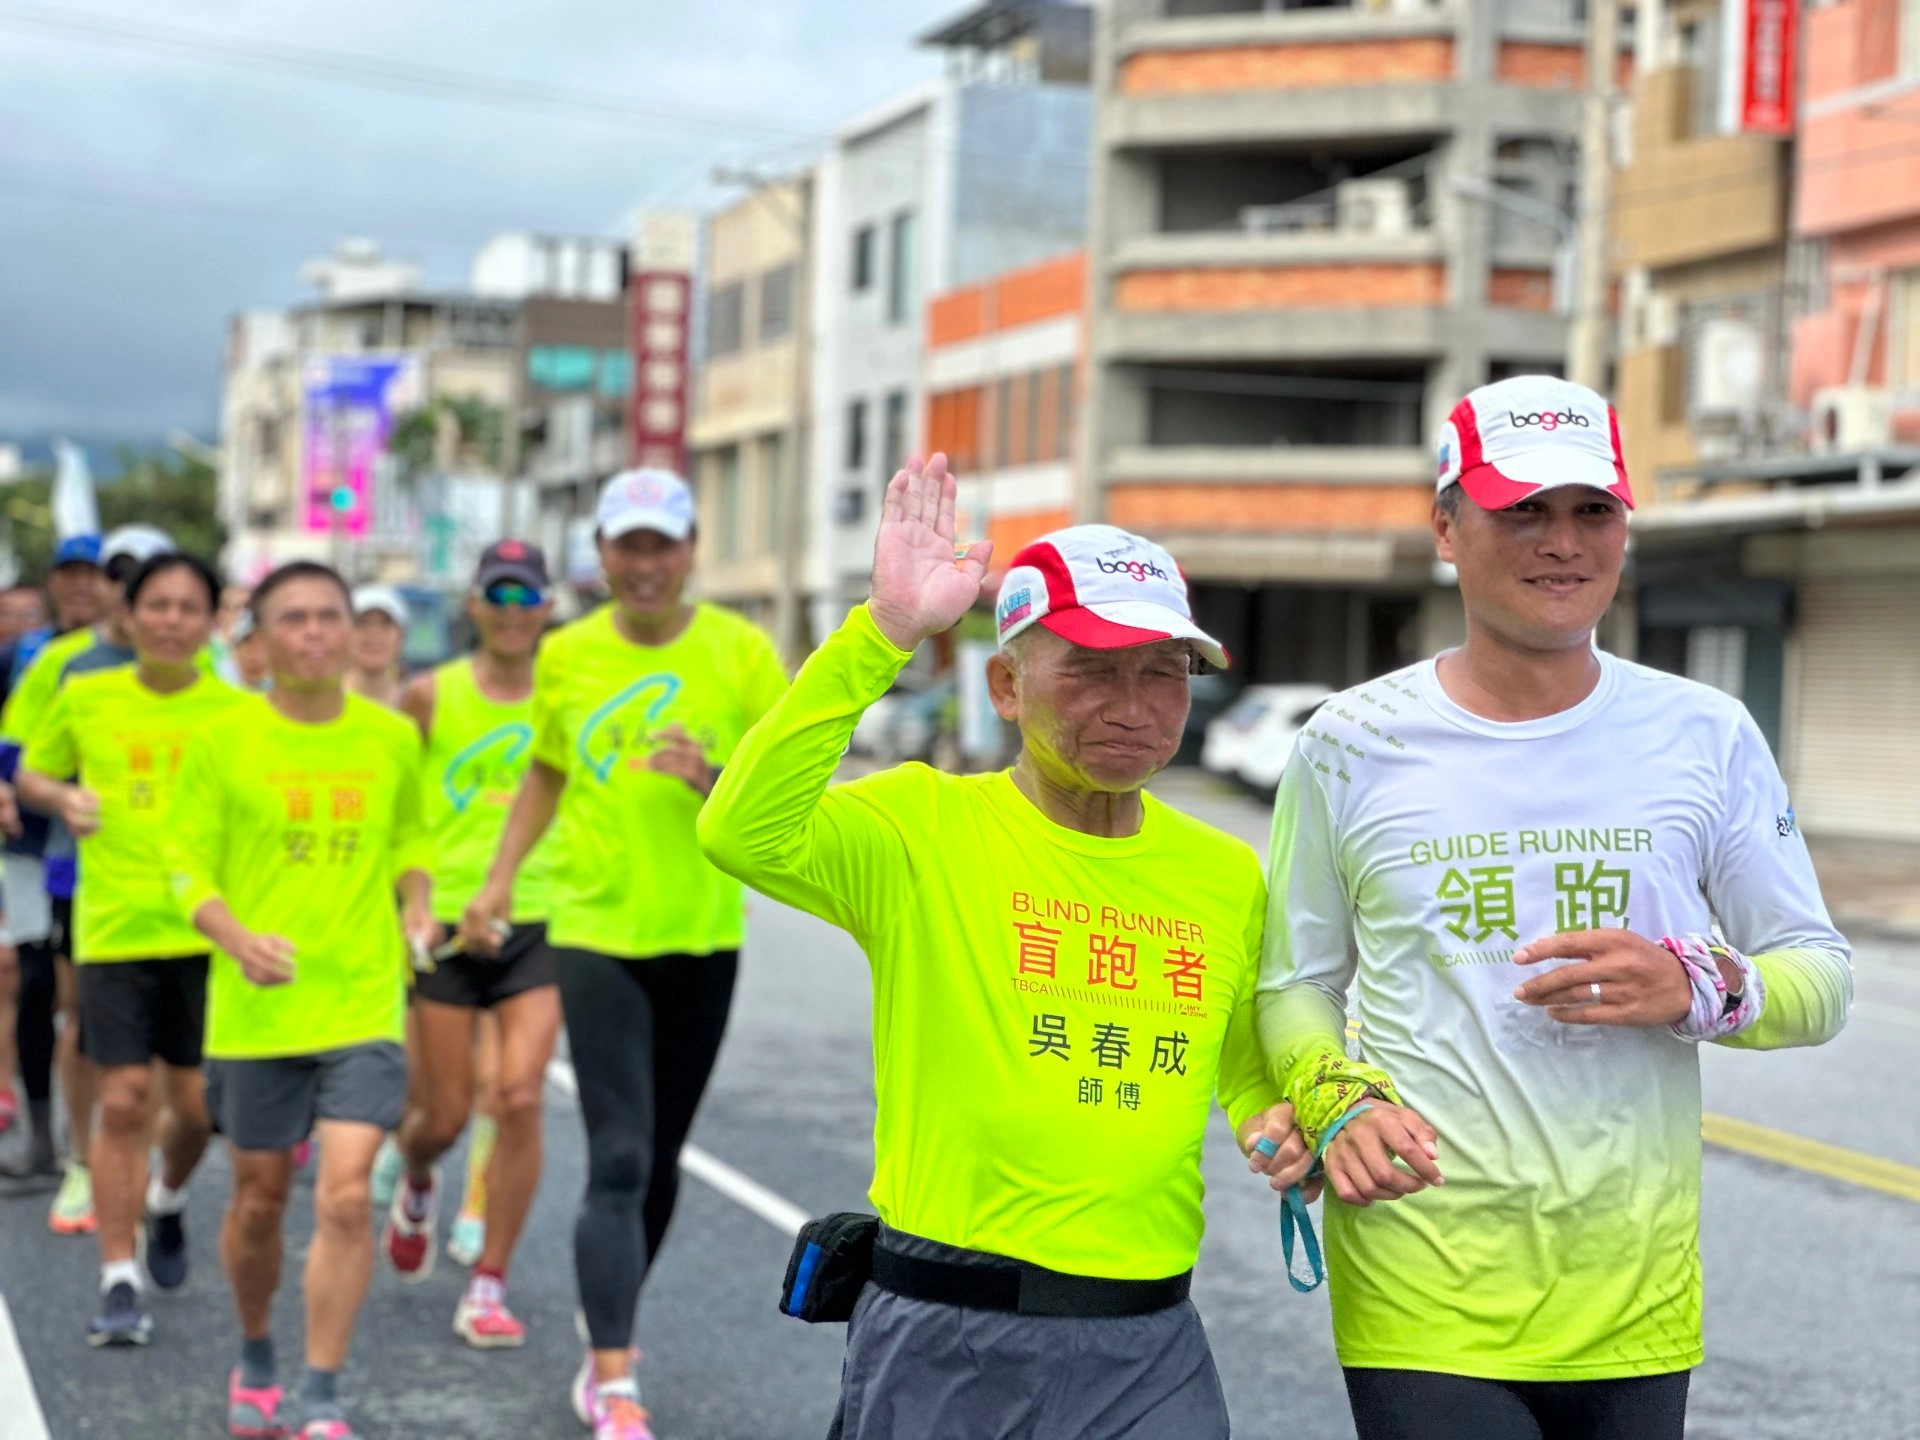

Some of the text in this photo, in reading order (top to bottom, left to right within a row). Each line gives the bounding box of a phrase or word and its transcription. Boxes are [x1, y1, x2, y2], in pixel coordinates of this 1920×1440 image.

[1409, 828, 1653, 865] GUIDE RUNNER
[1012, 891, 1205, 944] BLIND RUNNER
[1435, 859, 1631, 944] 領跑
[1011, 977, 1049, 995] TBCA
[1013, 920, 1207, 1002] 盲跑者
[1028, 1013, 1190, 1076] 吳春成
[1078, 1075, 1141, 1111] 師傅
